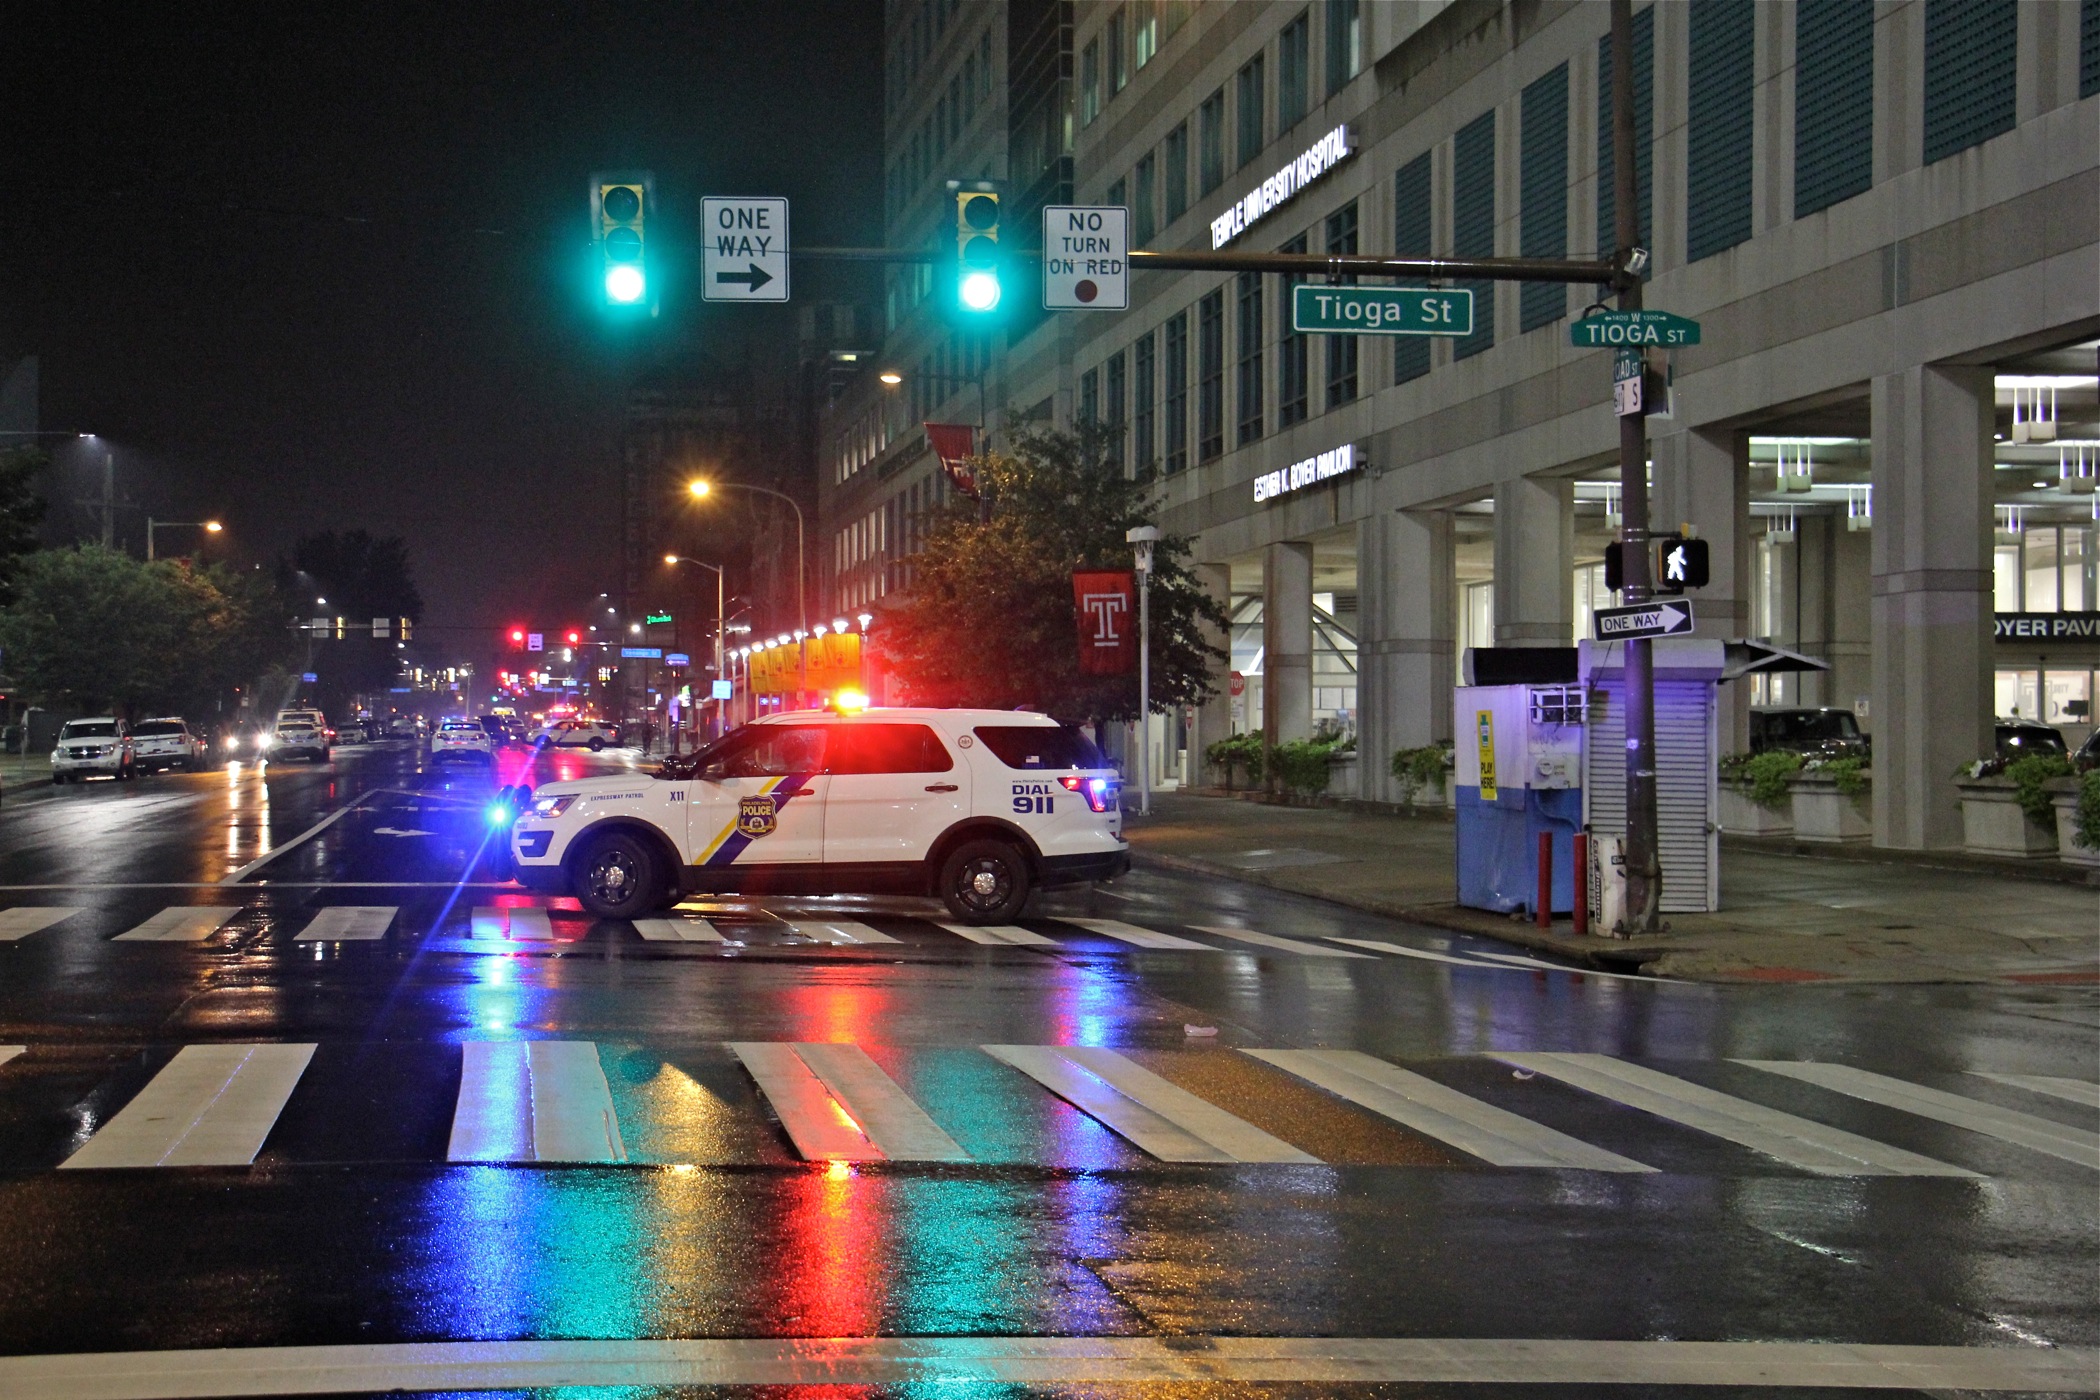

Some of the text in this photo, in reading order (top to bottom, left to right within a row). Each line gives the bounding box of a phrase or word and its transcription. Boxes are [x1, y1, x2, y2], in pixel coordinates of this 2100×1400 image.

[1210, 124, 1347, 250] TEMPLE UNIVERSITY HOSPITAL
[719, 207, 770, 230] ONE
[1069, 213, 1103, 231] NO
[717, 235, 772, 257] WAY
[1062, 237, 1110, 253] TURN
[1050, 258, 1121, 275] ON RED
[1314, 295, 1452, 328] Tioga St
[1631, 312, 1641, 322] W
[1585, 324, 1685, 343] TIOGA ST
[1632, 382, 1638, 406] S
[1254, 443, 1352, 503] ESTHER K. BOYER PAVILION
[1604, 613, 1660, 631] ONE WAY
[1230, 678, 1244, 689] TOP
[1481, 761, 1492, 775] PLAY
[591, 794, 624, 802] EXPRESSWAY
[670, 790, 685, 802] X11
[1012, 784, 1054, 795] DIAL
[743, 805, 771, 816] POLICE
[1012, 796, 1054, 814] 911
